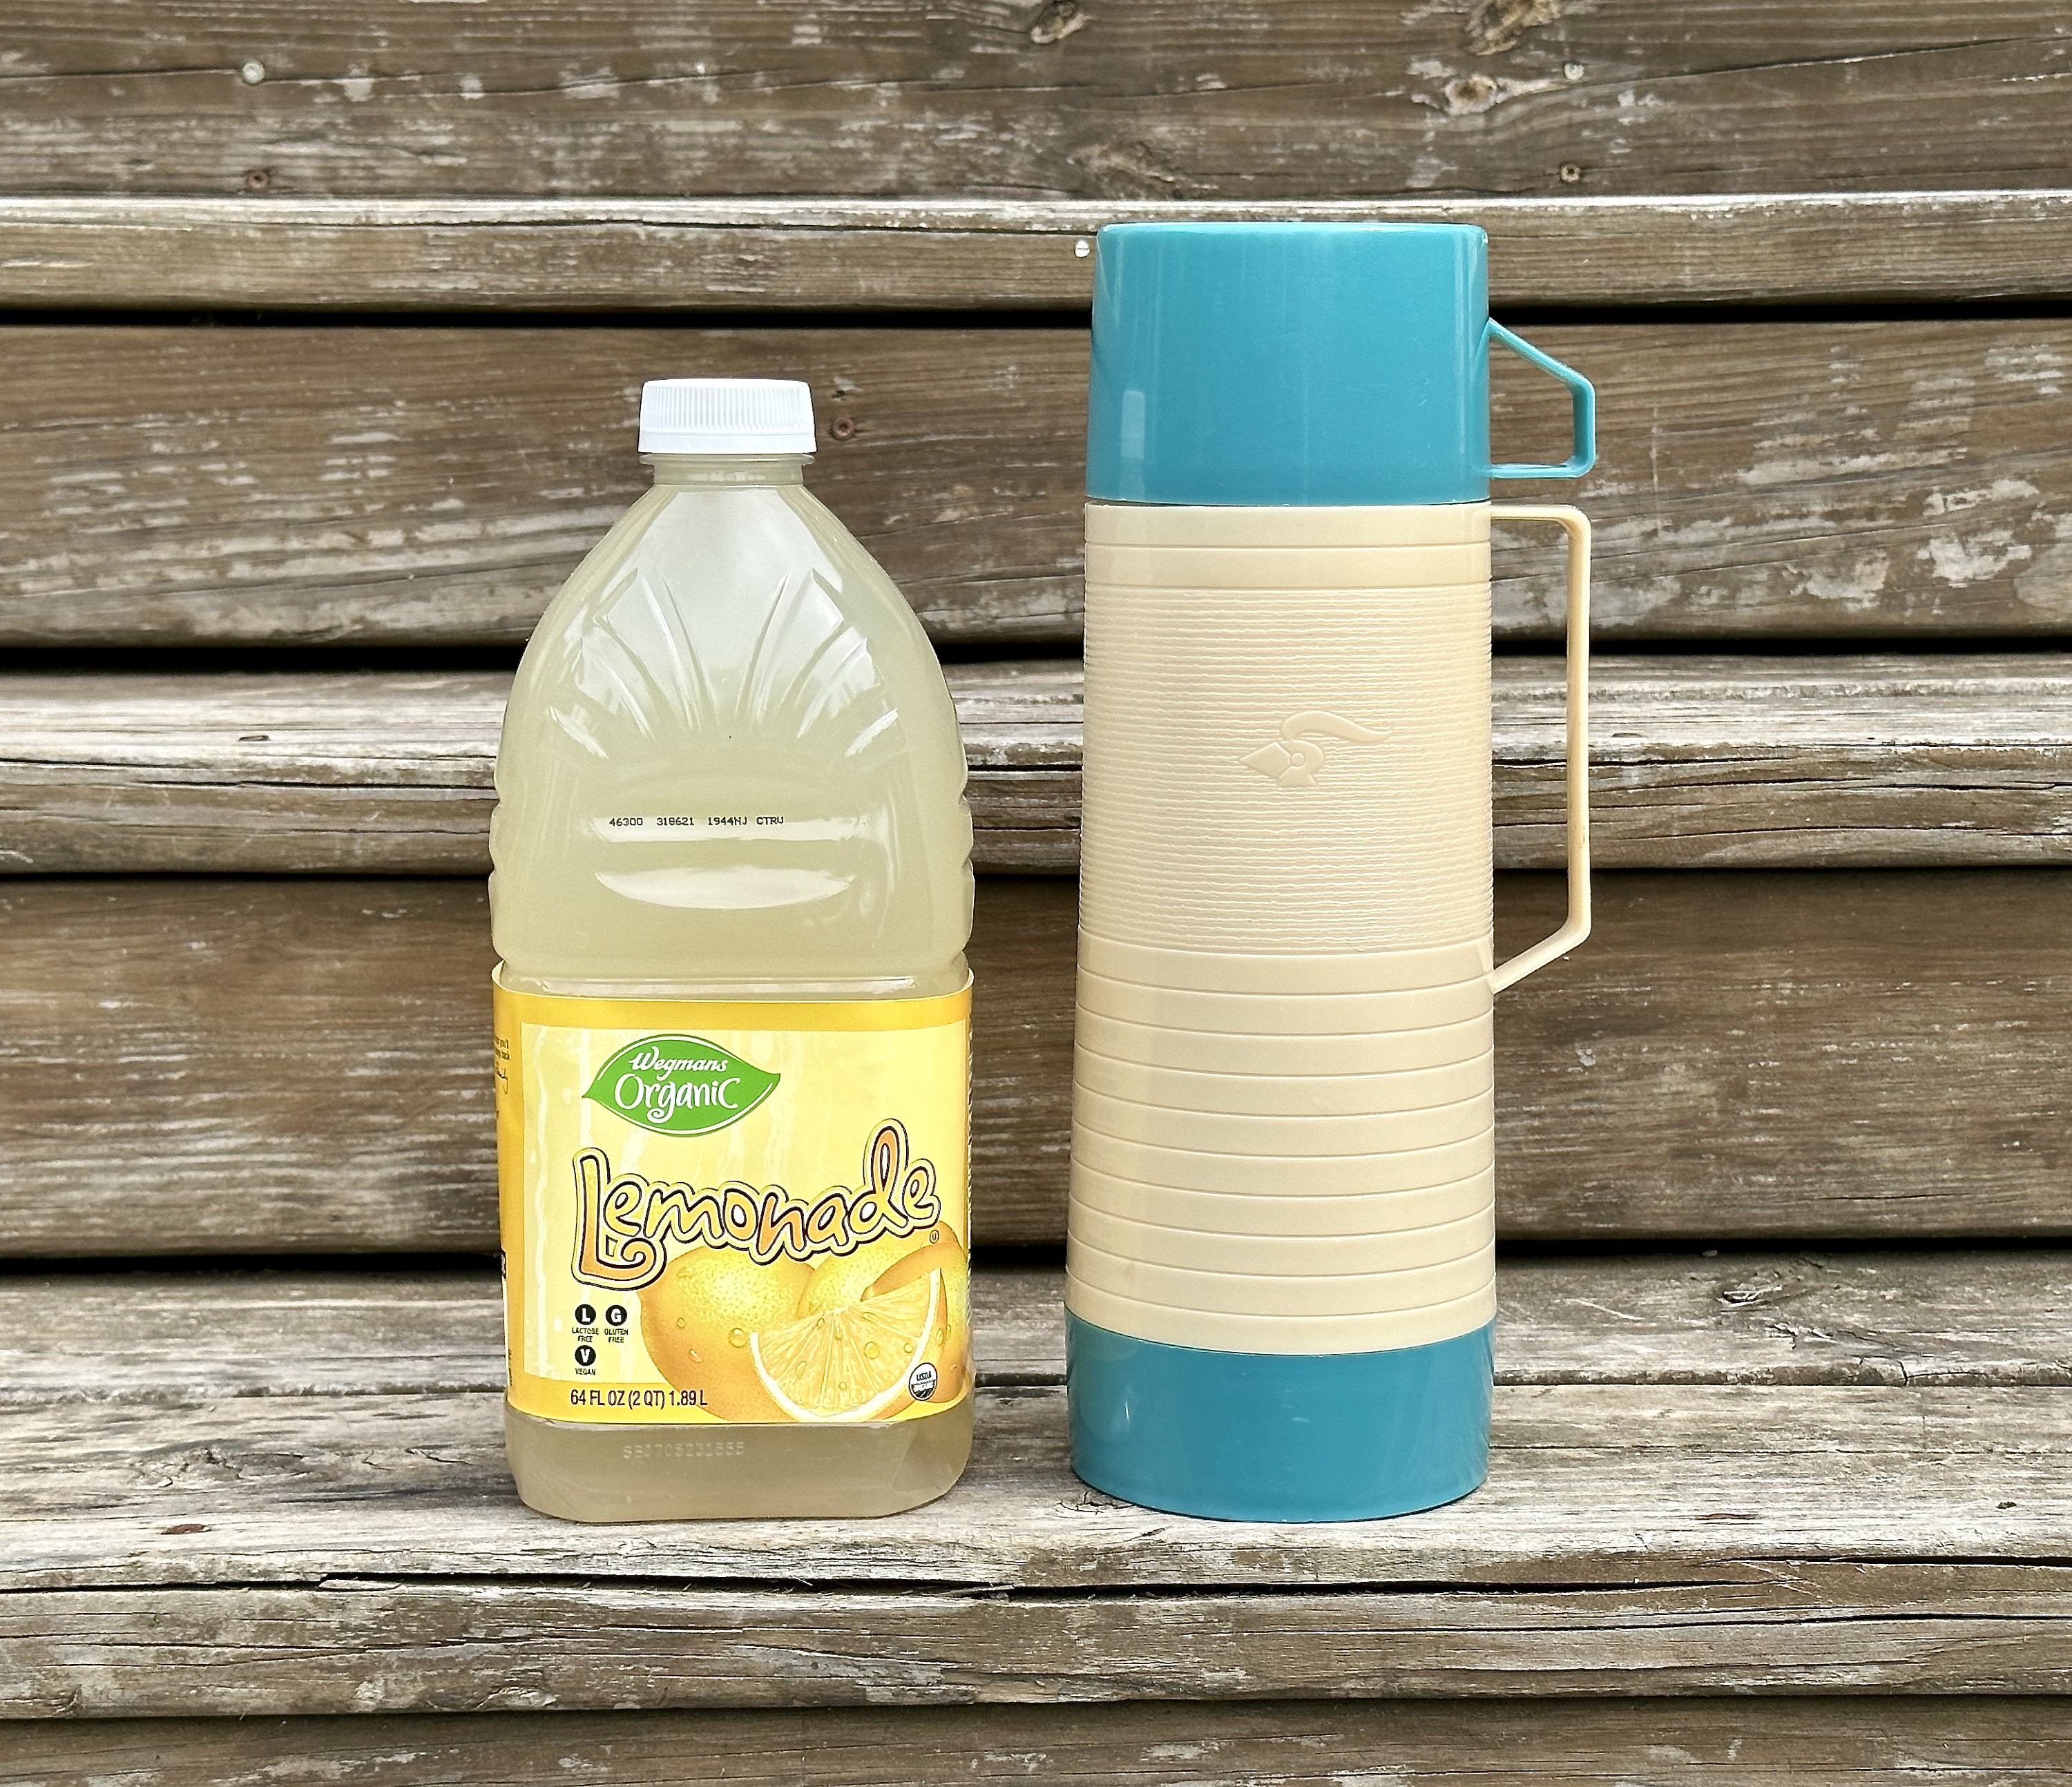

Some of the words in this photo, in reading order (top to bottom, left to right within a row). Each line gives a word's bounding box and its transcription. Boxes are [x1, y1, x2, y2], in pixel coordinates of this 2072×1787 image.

[609, 818, 643, 827] 46300
[656, 817, 694, 826] 318621
[756, 816, 784, 825] CTRU
[628, 1045, 729, 1081] Wegmans
[572, 1119, 941, 1291] Lemonade
[571, 1327, 599, 1335] LACTOSE
[575, 1367, 596, 1376] VEGAN
[916, 1371, 932, 1382] USDA
[570, 1389, 586, 1406] 64
[590, 1390, 605, 1406] FL
[608, 1390, 625, 1407] OZ
[628, 1390, 641, 1410] (2
[644, 1390, 665, 1410] QT)
[669, 1390, 697, 1407] 1.89
[700, 1389, 708, 1406] L
